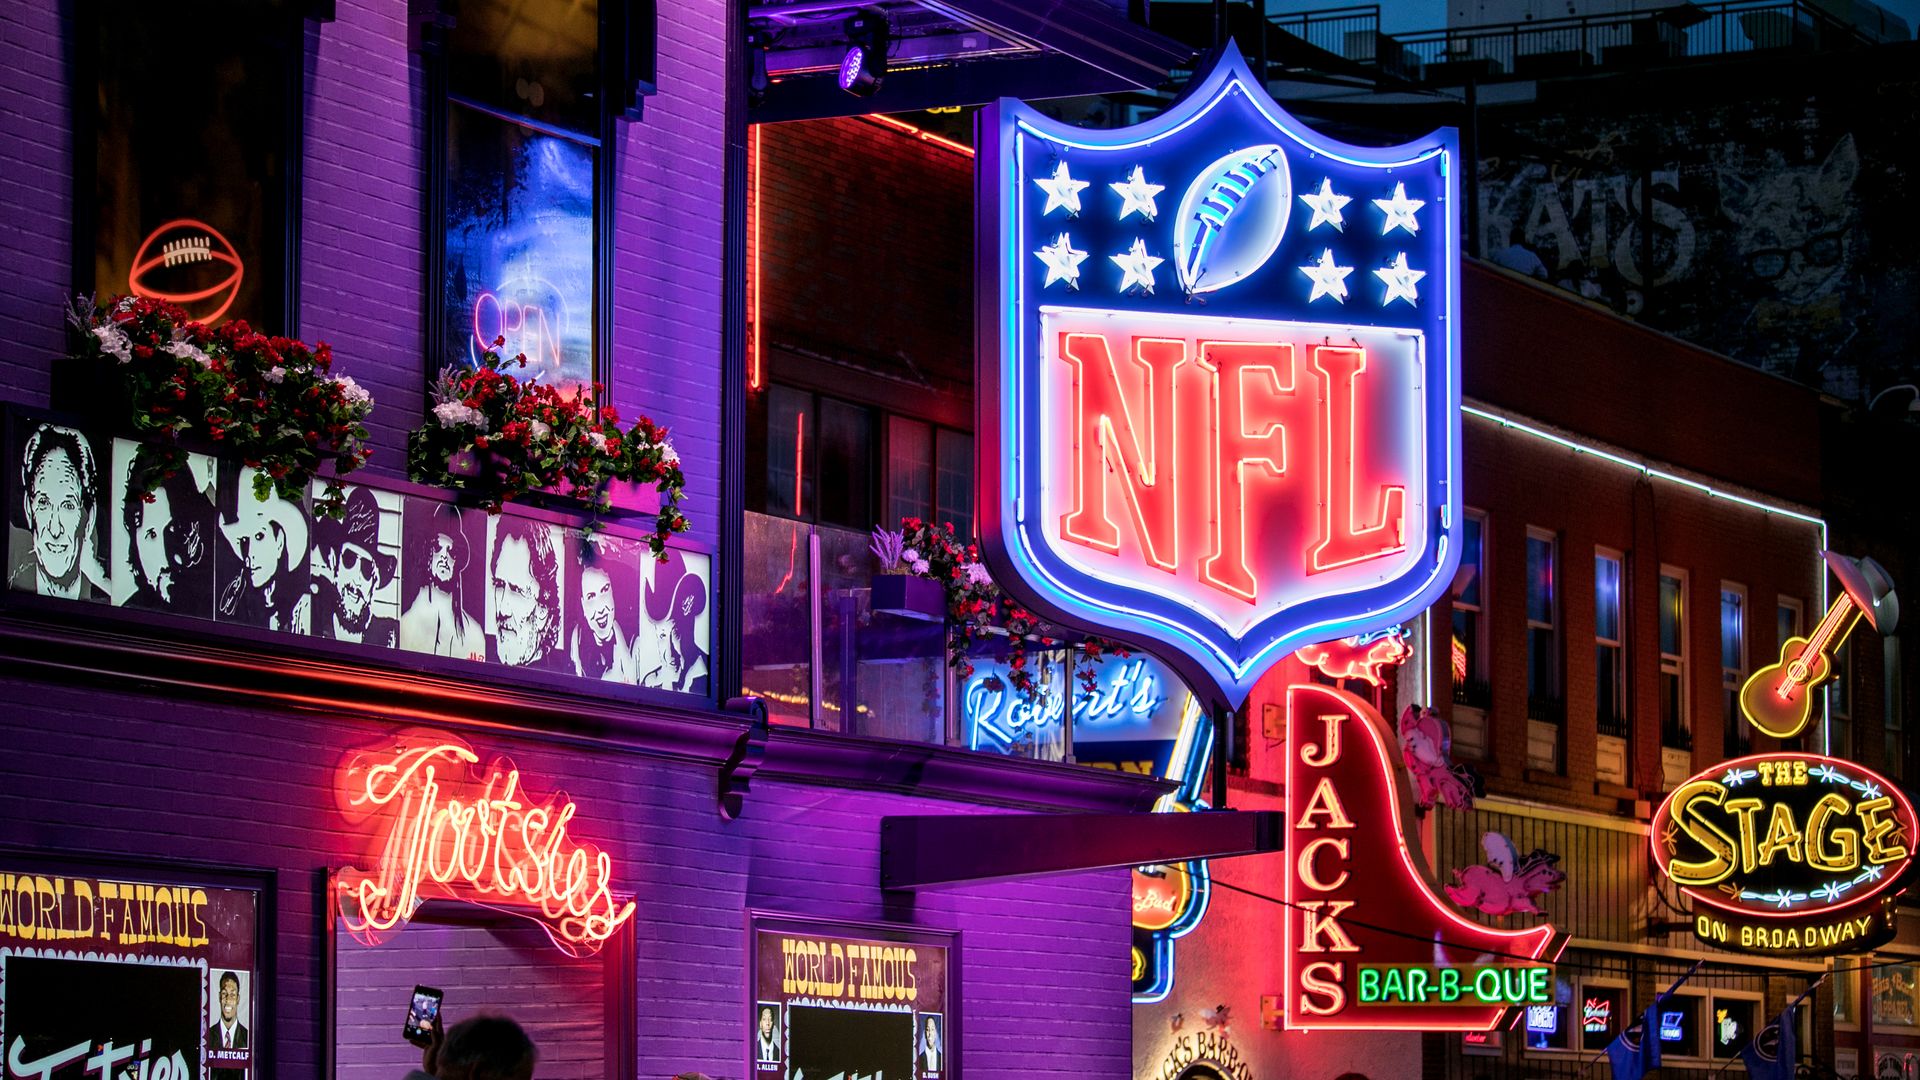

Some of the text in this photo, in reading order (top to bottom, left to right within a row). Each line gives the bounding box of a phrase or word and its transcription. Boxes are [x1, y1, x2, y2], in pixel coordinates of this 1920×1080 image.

[1477, 162, 1696, 288] KATS
[475, 293, 560, 368] OPEN
[1059, 331, 1407, 606] NFL
[966, 659, 1156, 751] Robert's
[1758, 761, 1809, 787] THE
[360, 744, 637, 941] Tootsies
[1296, 714, 1360, 1016] JACKS
[1669, 780, 1908, 885] STAGE
[0, 874, 209, 948] WORLD FAMOUS
[1697, 914, 1872, 948] ON BROADWAY
[782, 938, 918, 1001] WORLD FAMOUS
[1359, 967, 1550, 1002] BAR-B-QUE
[208, 1050, 250, 1060] D. METCALF
[761, 1063, 778, 1071] ALLEN
[1156, 1036, 1193, 1080] CK'S
